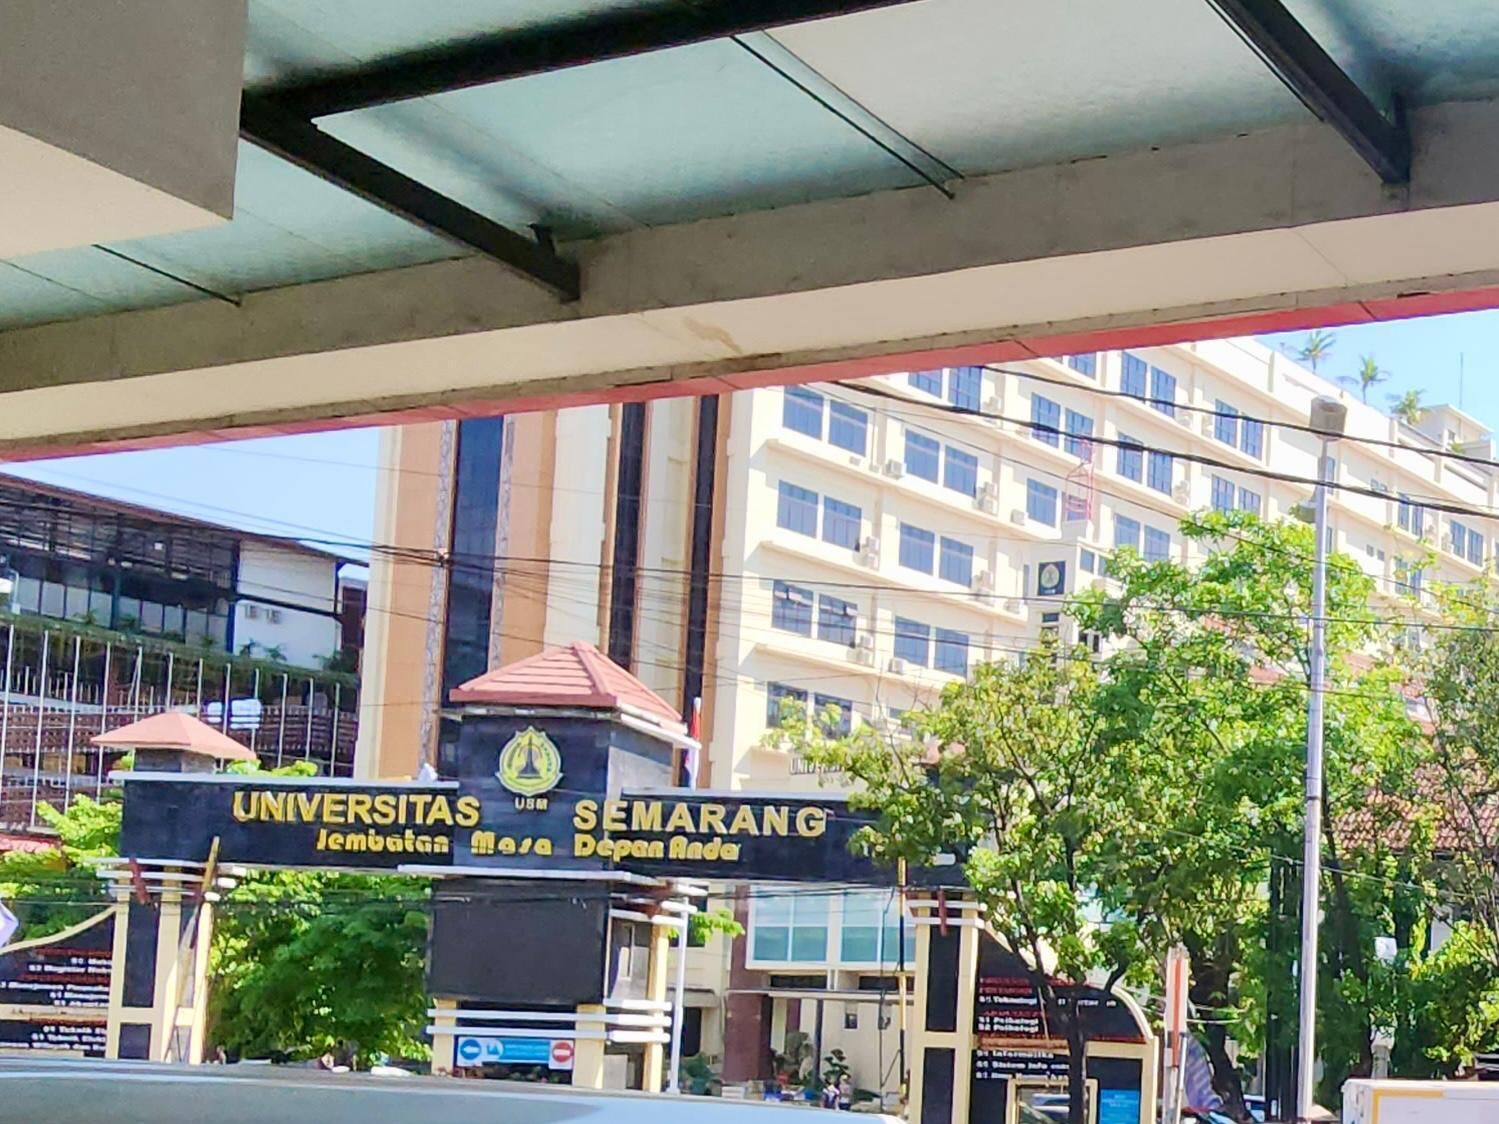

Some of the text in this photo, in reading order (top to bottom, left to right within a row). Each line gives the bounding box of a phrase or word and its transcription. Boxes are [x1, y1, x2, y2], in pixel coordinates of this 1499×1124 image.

[232, 790, 829, 838] UNIVERSITAS SEMARANG
[316, 829, 740, 864] Jembatan Masa Depan Anda
